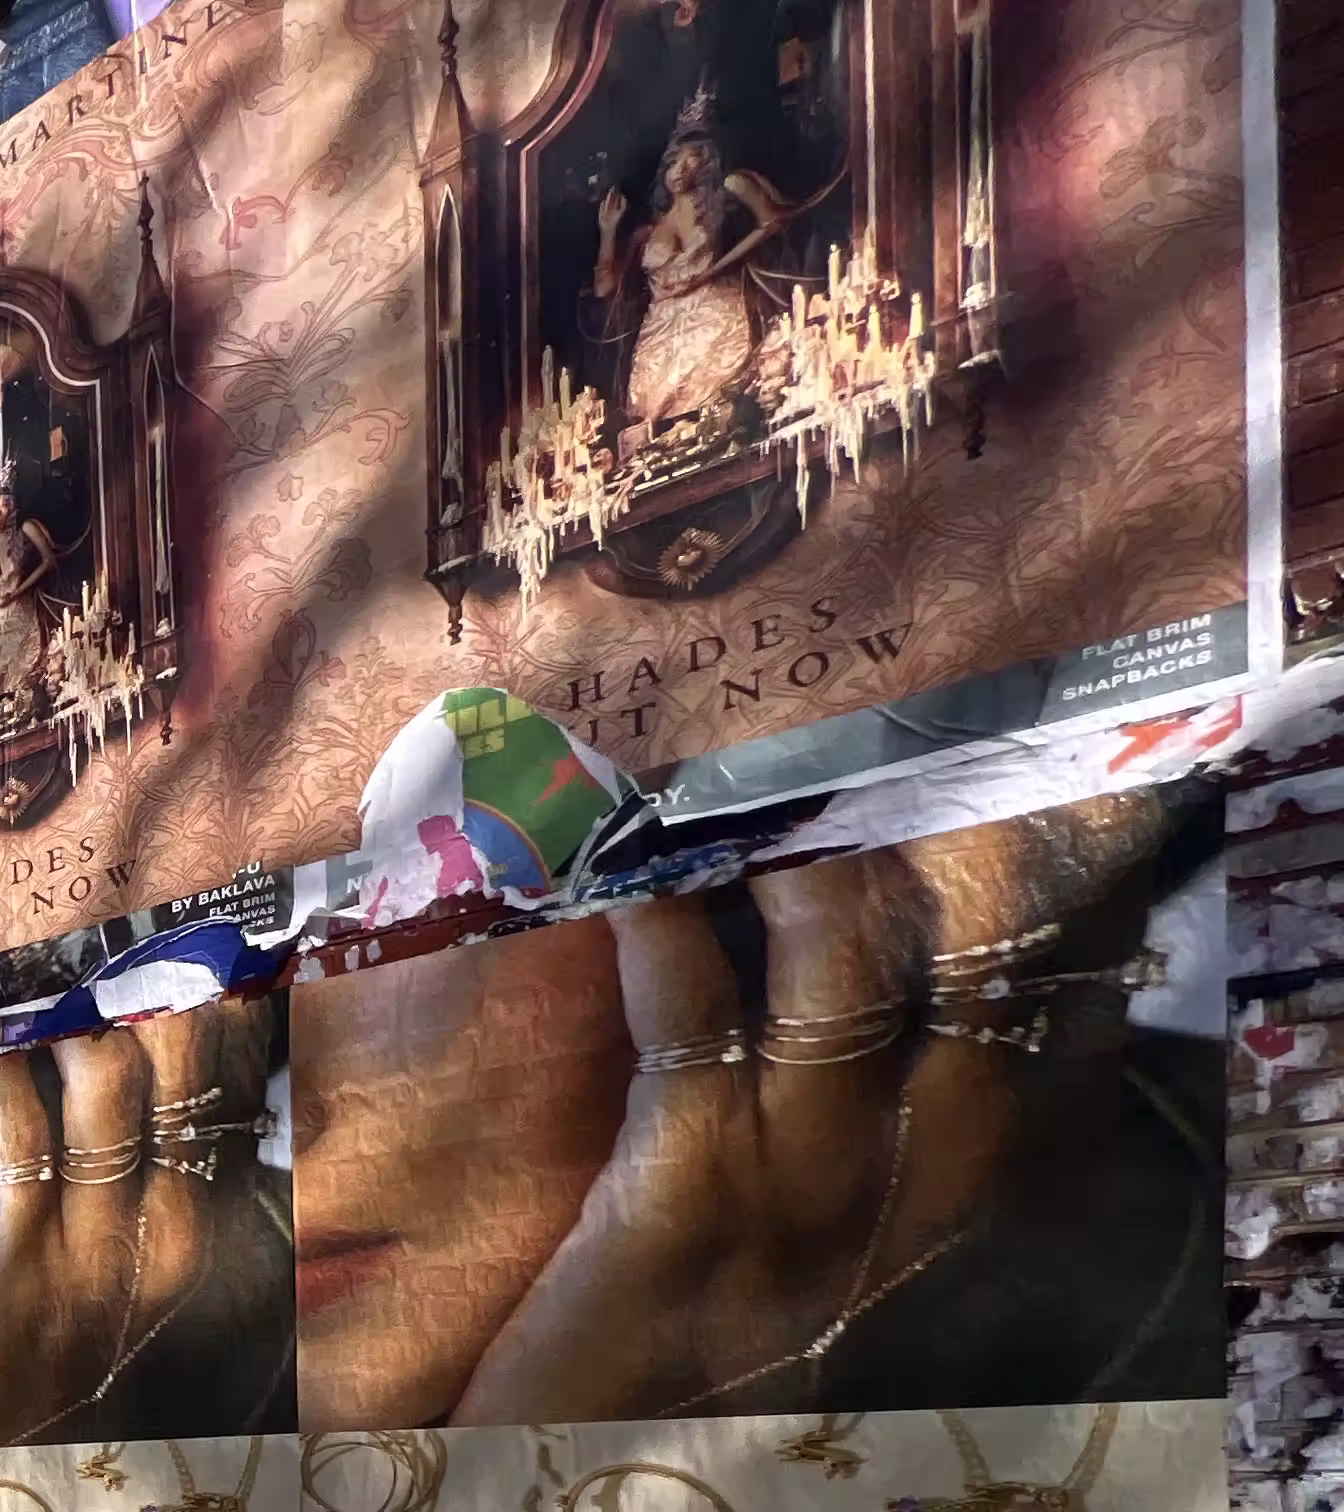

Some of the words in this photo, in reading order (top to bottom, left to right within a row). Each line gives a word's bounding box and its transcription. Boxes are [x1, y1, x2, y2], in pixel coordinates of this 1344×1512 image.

[565, 595, 840, 712] HADES
[1081, 633, 1138, 661] FLAT
[1146, 612, 1213, 644] BRIM
[1112, 631, 1212, 669] CANVAS
[719, 621, 915, 713] NOW
[1062, 649, 1212, 701] SNAPBACKS
[30, 859, 137, 916] NOW
[171, 895, 194, 913] BY
[198, 873, 277, 906] BAKLAVA
[209, 901, 239, 918] FLAT
[242, 891, 277, 910] BRIM
[233, 904, 277, 923] ANVAS
